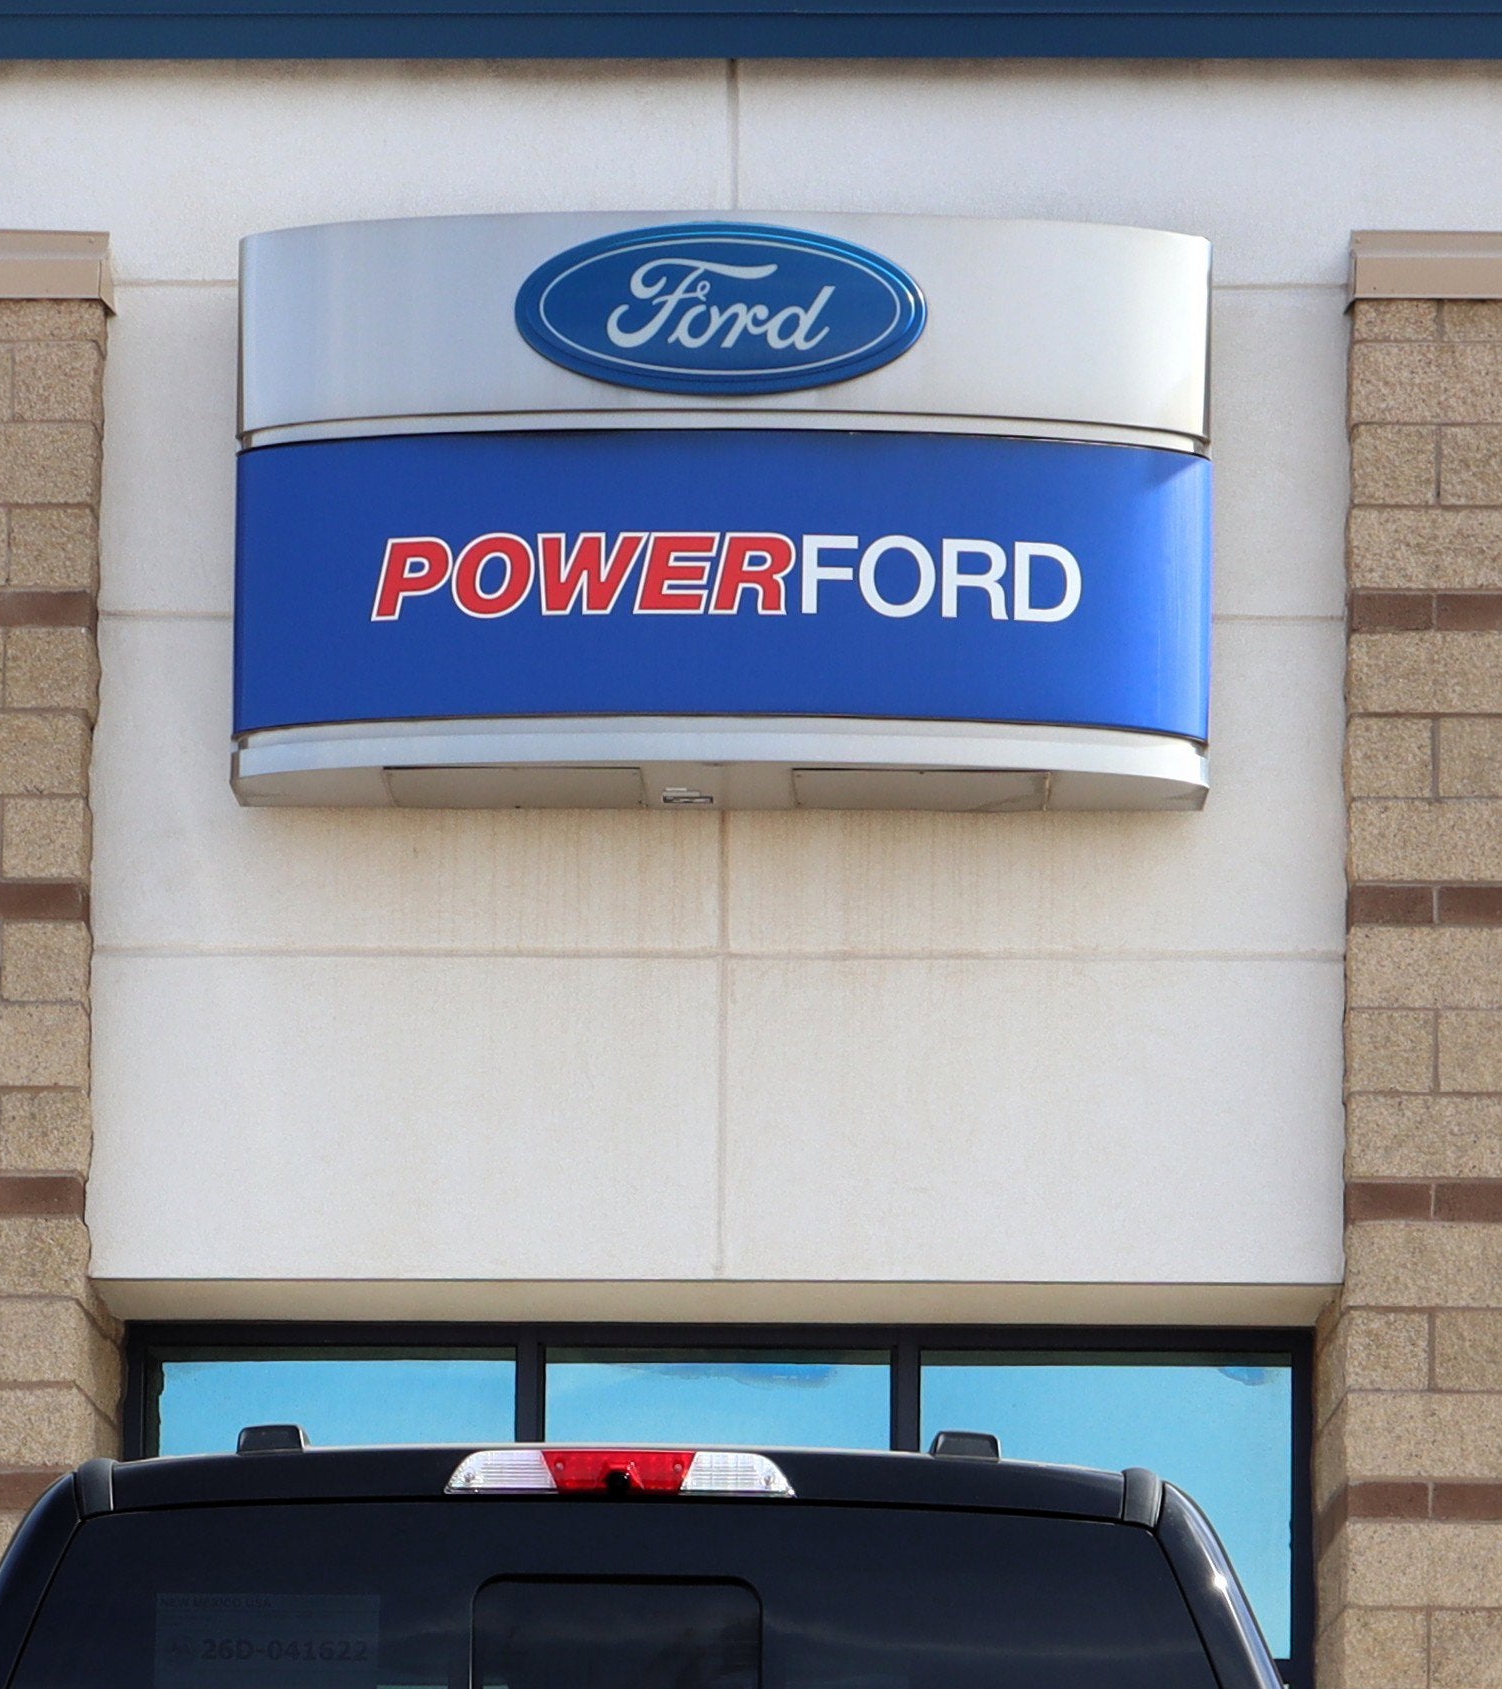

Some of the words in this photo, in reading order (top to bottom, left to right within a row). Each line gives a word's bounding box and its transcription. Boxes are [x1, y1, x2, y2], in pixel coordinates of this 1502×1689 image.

[604, 255, 835, 352] Ford
[370, 531, 1083, 623] POWERFORD
[246, 1597, 272, 1608] USA
